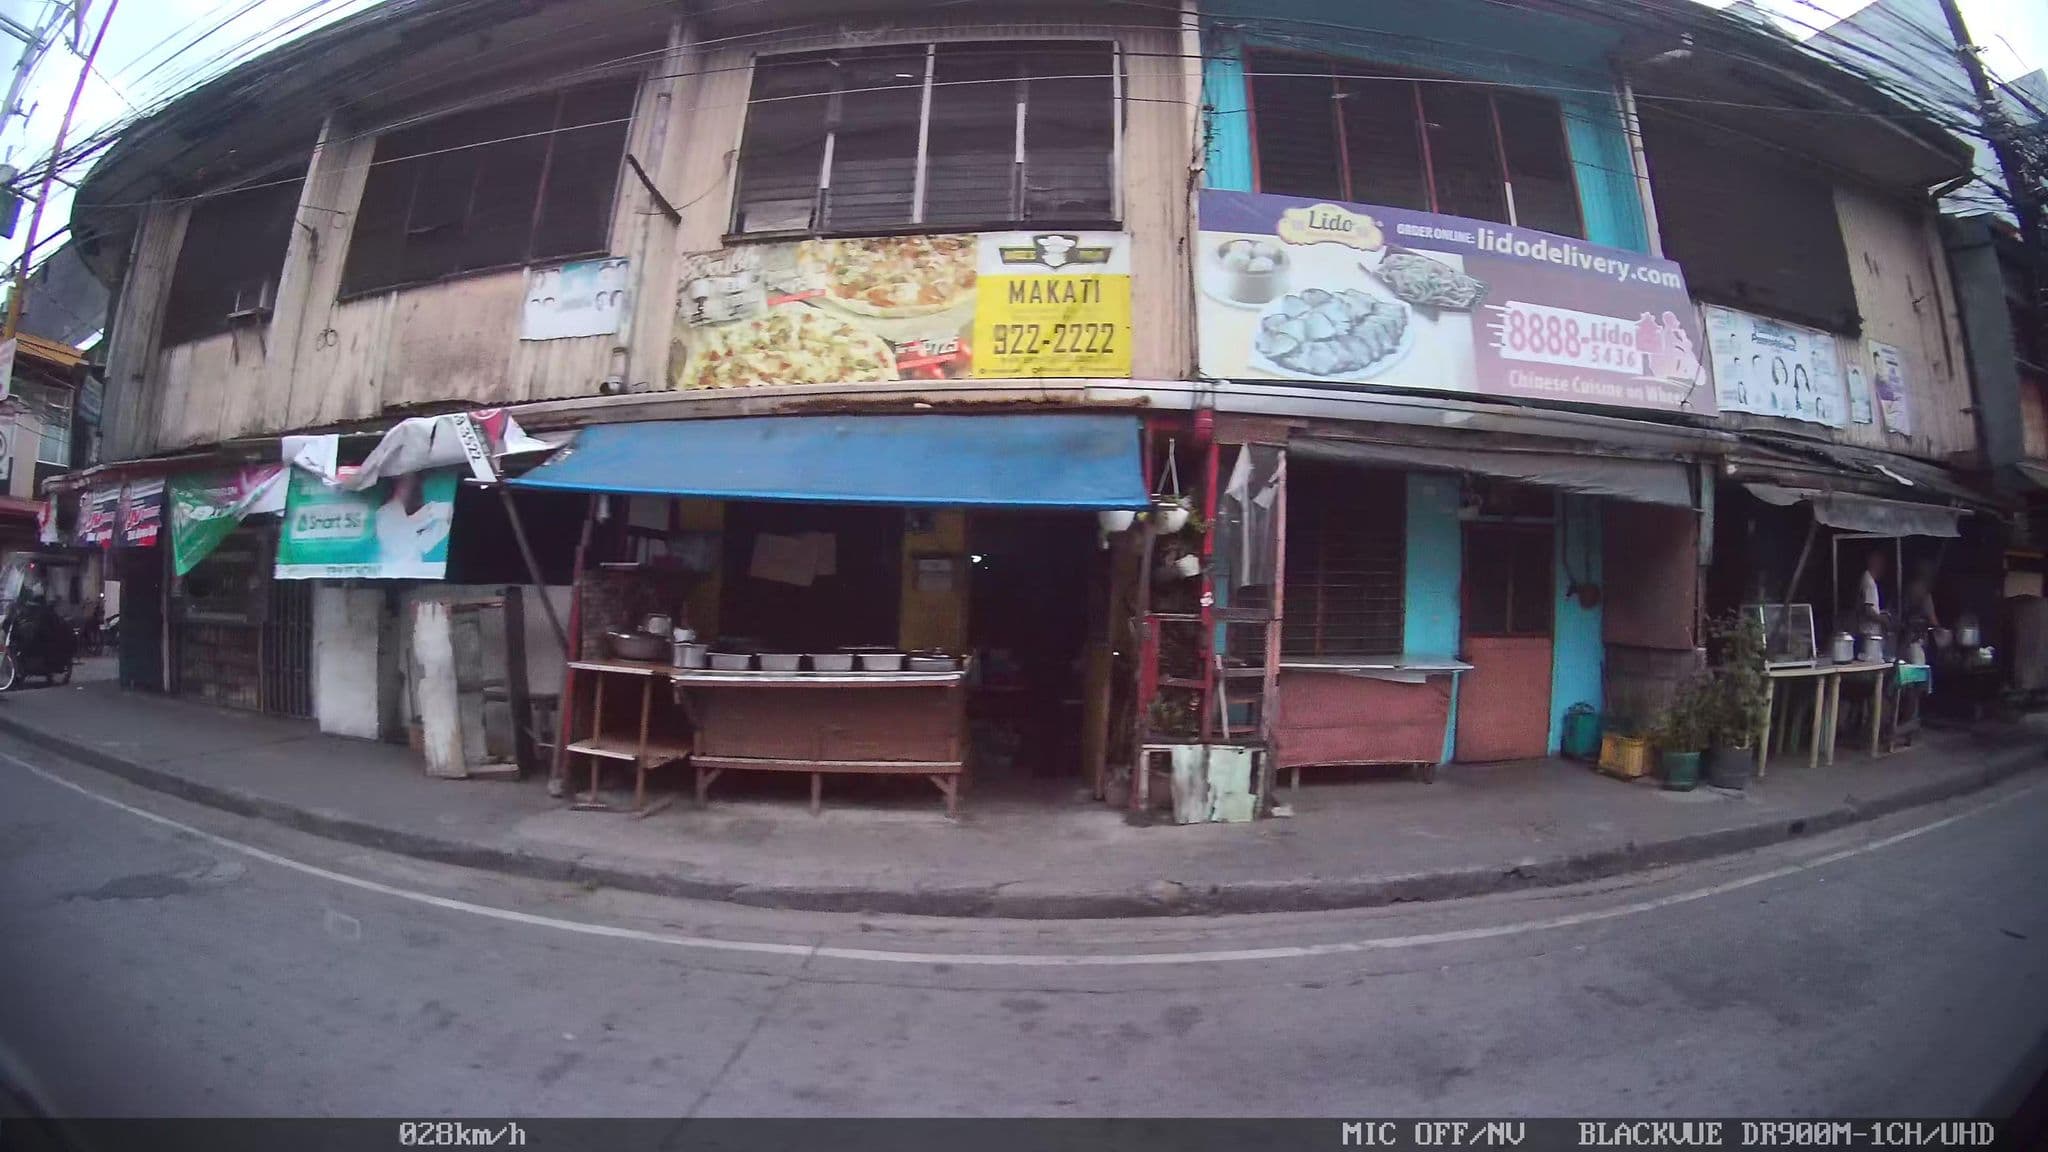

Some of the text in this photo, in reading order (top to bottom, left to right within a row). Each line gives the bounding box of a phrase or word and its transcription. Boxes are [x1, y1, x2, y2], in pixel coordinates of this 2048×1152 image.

[1308, 210, 1354, 232] Lido
[1397, 223, 1682, 289] ORDER ONLINE: lidodelivery.com
[1009, 279, 1101, 304] MAKATI
[993, 323, 1115, 355] 922-2222
[1590, 345, 1637, 368] 5436
[1509, 368, 1569, 392] Chinese
[309, 511, 342, 530] Smart
